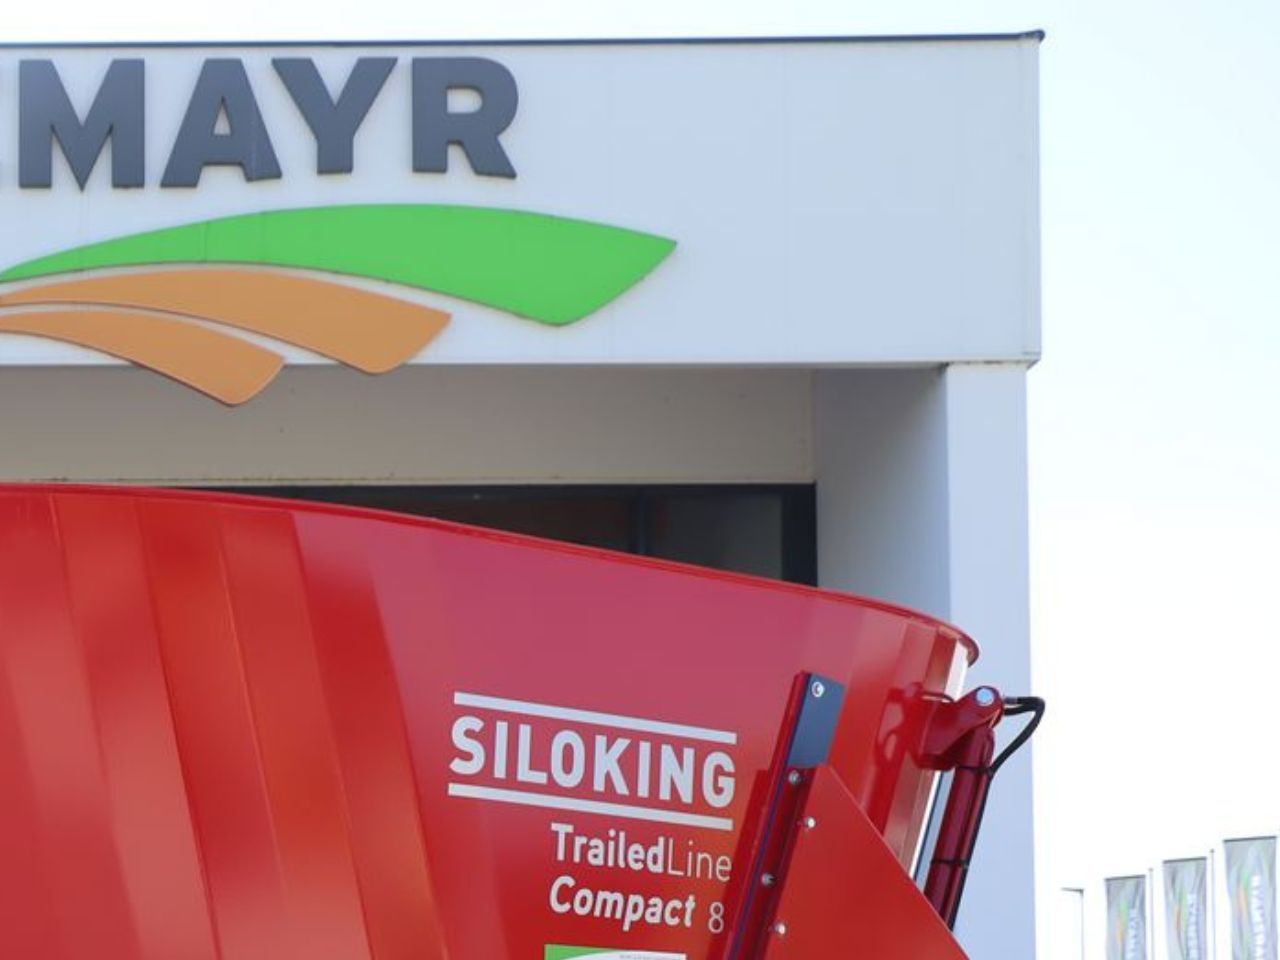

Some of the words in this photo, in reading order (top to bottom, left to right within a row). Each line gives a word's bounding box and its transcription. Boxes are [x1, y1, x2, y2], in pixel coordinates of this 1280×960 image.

[449, 715, 736, 808] SILOKING
[550, 822, 733, 883] TrailedLine
[549, 875, 696, 932] Compact
[707, 901, 725, 934] 8
